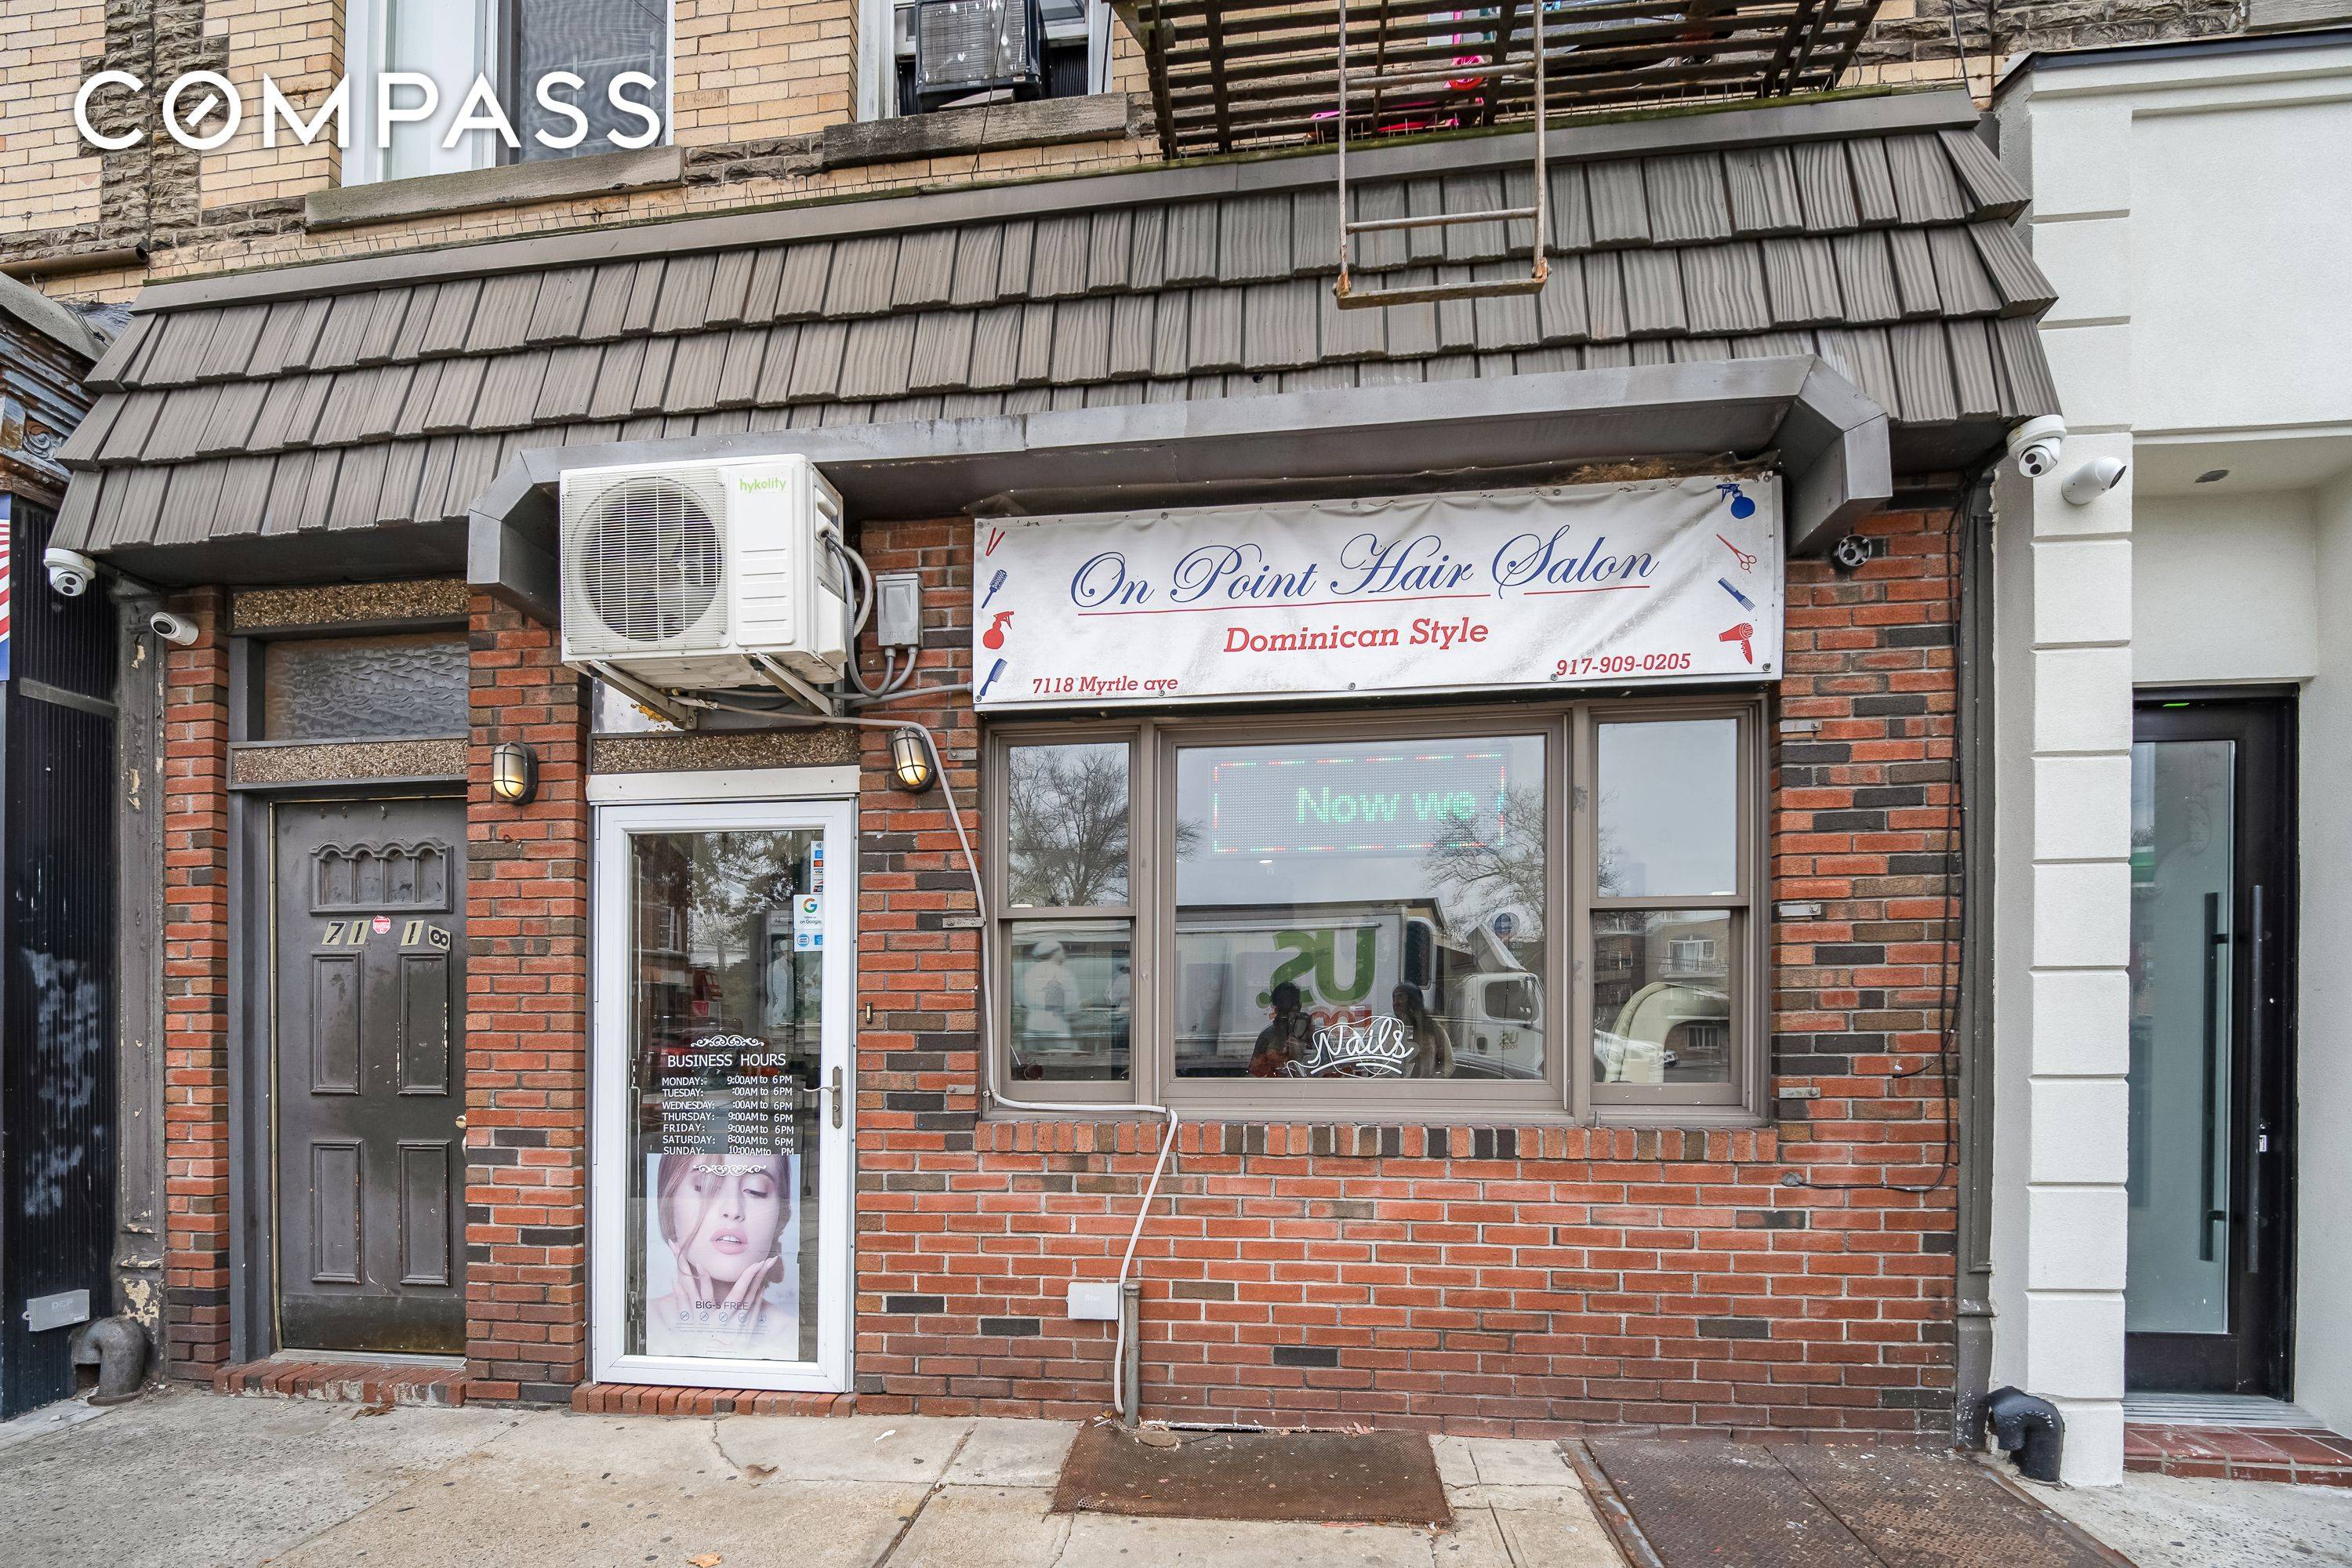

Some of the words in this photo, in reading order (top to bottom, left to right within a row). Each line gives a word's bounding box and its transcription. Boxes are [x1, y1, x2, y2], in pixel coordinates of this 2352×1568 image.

[739, 477, 786, 493] hykolity
[1071, 552, 1154, 608] On
[1171, 544, 1319, 603] Point
[1330, 533, 1473, 596] Hair
[1492, 524, 1659, 599] Salon
[1224, 625, 1399, 652] Dominican
[1410, 617, 1488, 650] Style
[1556, 653, 1691, 676] 917-909-0205
[1033, 677, 1074, 694] 7118
[1078, 676, 1139, 695] Myrtle
[1144, 678, 1178, 691] ave
[1296, 786, 1401, 823] Now
[1412, 791, 1478, 820] we
[1308, 1018, 1414, 1065] Nails
[668, 1054, 732, 1067] BUSINESS
[741, 1054, 786, 1066] HOURS
[662, 1076, 704, 1086] MONDAY:
[727, 1075, 757, 1084] 9:00AM
[662, 1088, 704, 1097] TUESDAY:
[760, 1087, 768, 1096] to
[773, 1087, 793, 1096] 6PM
[662, 1101, 715, 1109] WEDNESDAY:
[773, 1102, 793, 1110] 6PM
[662, 1112, 715, 1121] THURSDAY:
[728, 1112, 759, 1121] 9:00AM
[760, 1112, 768, 1121] to
[774, 1114, 793, 1123] 6PM
[663, 1123, 706, 1132] FRIDAY:
[728, 1124, 759, 1134] 9:00AM
[662, 1135, 716, 1145] SATURDAY:
[728, 1134, 758, 1145] 8:00AM
[775, 1137, 793, 1146] 6PM
[663, 1147, 705, 1156] SUNDAY:
[781, 1148, 794, 1156] PM
[724, 1301, 749, 1311] FREE
